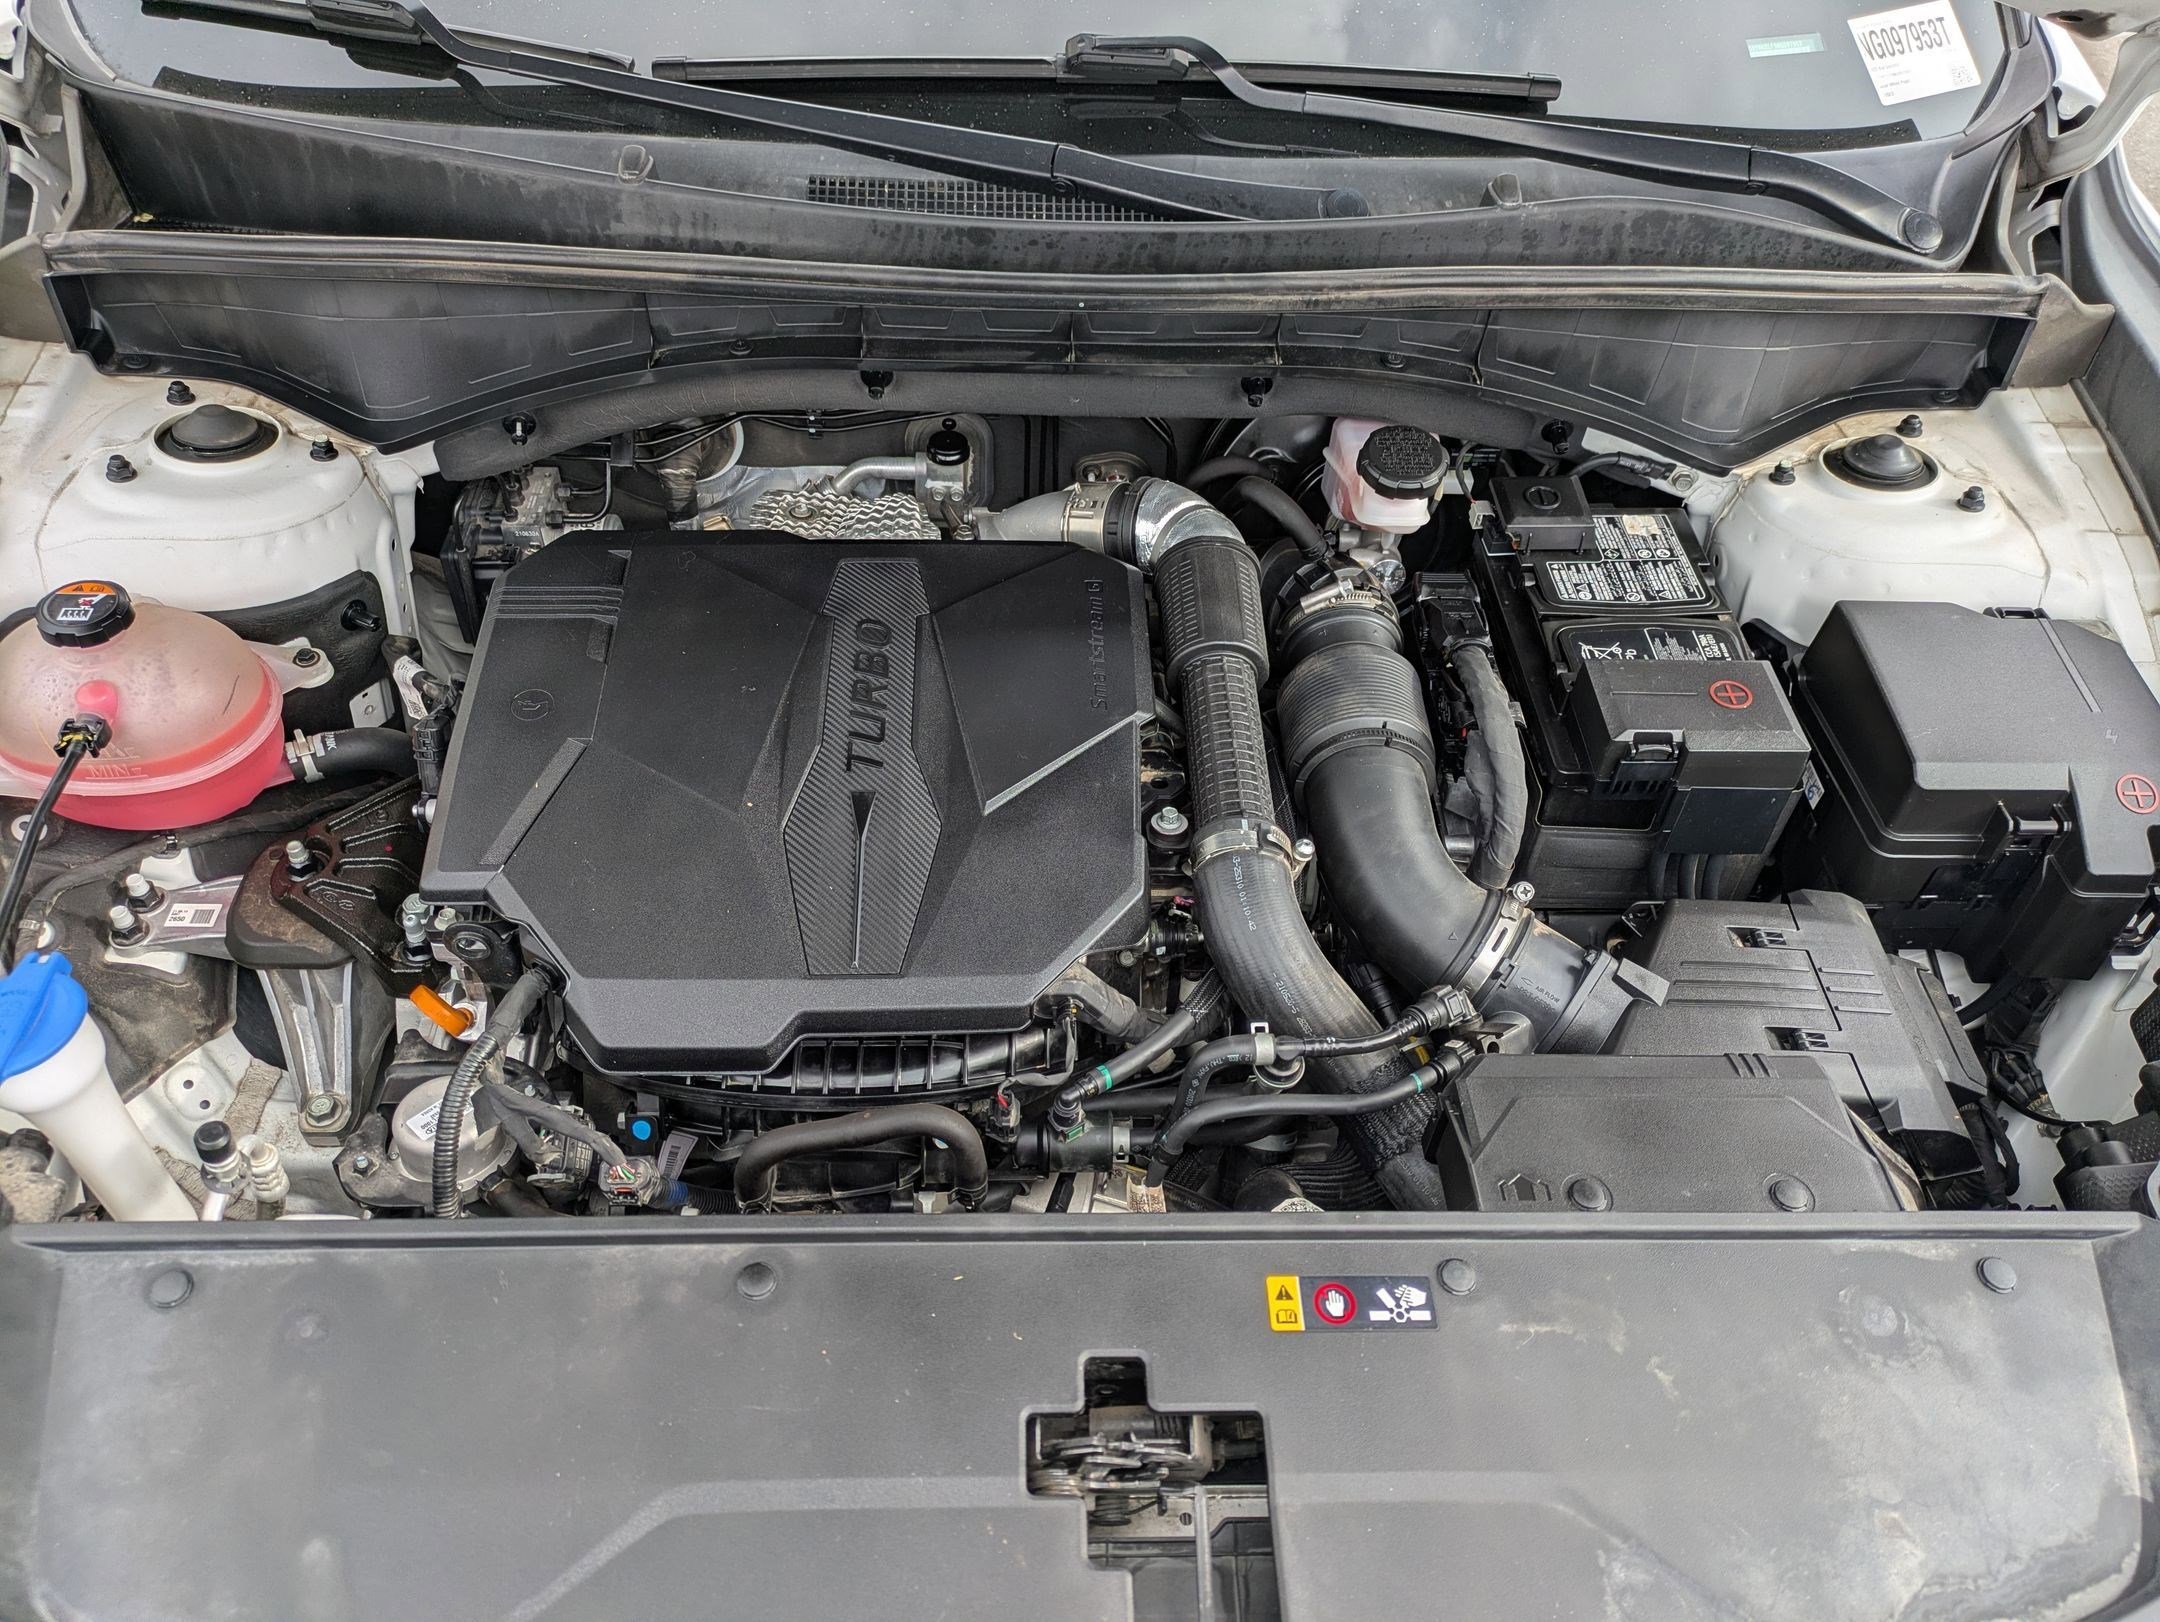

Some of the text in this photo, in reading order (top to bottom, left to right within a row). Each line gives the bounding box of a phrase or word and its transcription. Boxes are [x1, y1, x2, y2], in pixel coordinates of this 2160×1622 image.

[846, 618, 892, 772] TURBO
[1088, 596, 1108, 710] Smartstream
[89, 764, 131, 777] MIN
